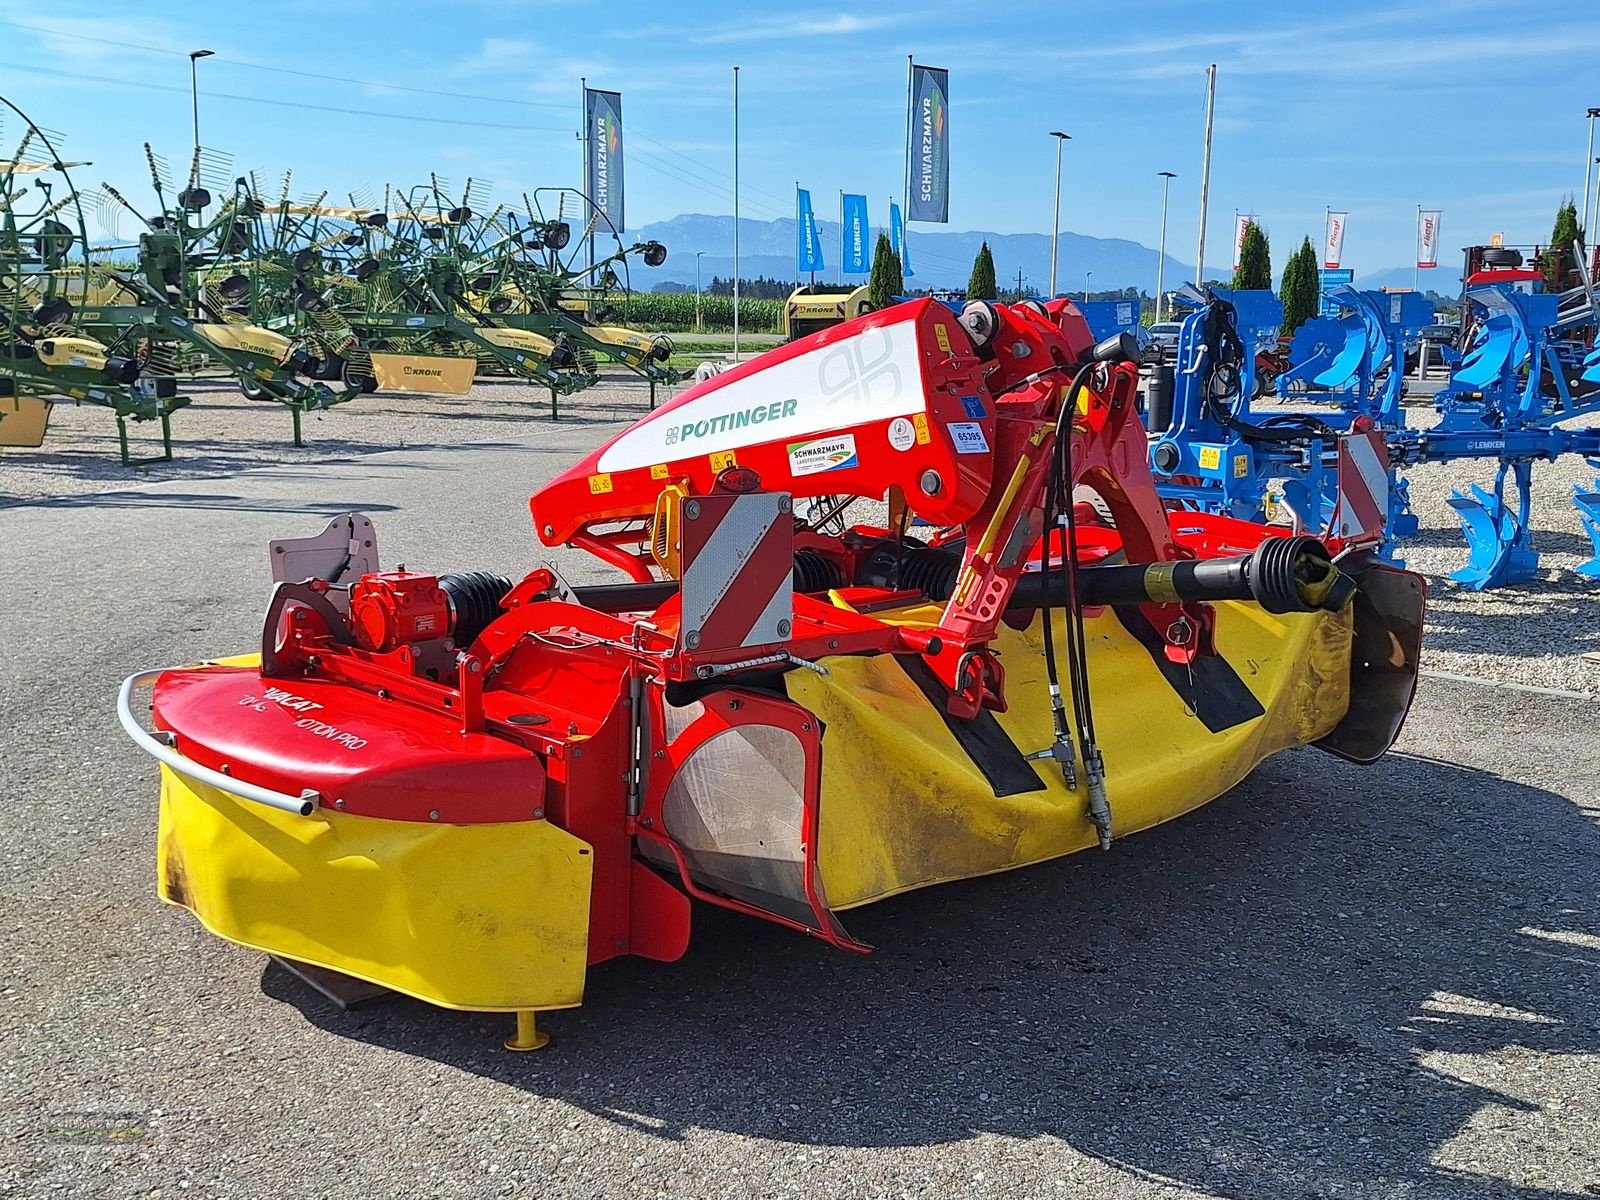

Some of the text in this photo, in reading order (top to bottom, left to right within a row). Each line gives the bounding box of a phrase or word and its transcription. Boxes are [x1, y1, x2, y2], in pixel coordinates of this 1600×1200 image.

[921, 97, 933, 202] SCHWARZMAYR
[597, 117, 607, 214] SCHWARZMAYR
[804, 213, 814, 255] LEMKEN
[853, 217, 863, 257] LEMKEN
[1330, 219, 1340, 248] Fliegl
[1423, 218, 1433, 247] Fliegl
[805, 305, 835, 313] KRONE
[248, 344, 277, 356] KRONE
[412, 369, 442, 377] KRONE
[957, 432, 981, 441] 65395
[1474, 441, 1506, 449] LEMKEN
[794, 443, 845, 459] SCHWARZMAYR
[334, 732, 368, 750] PRO
